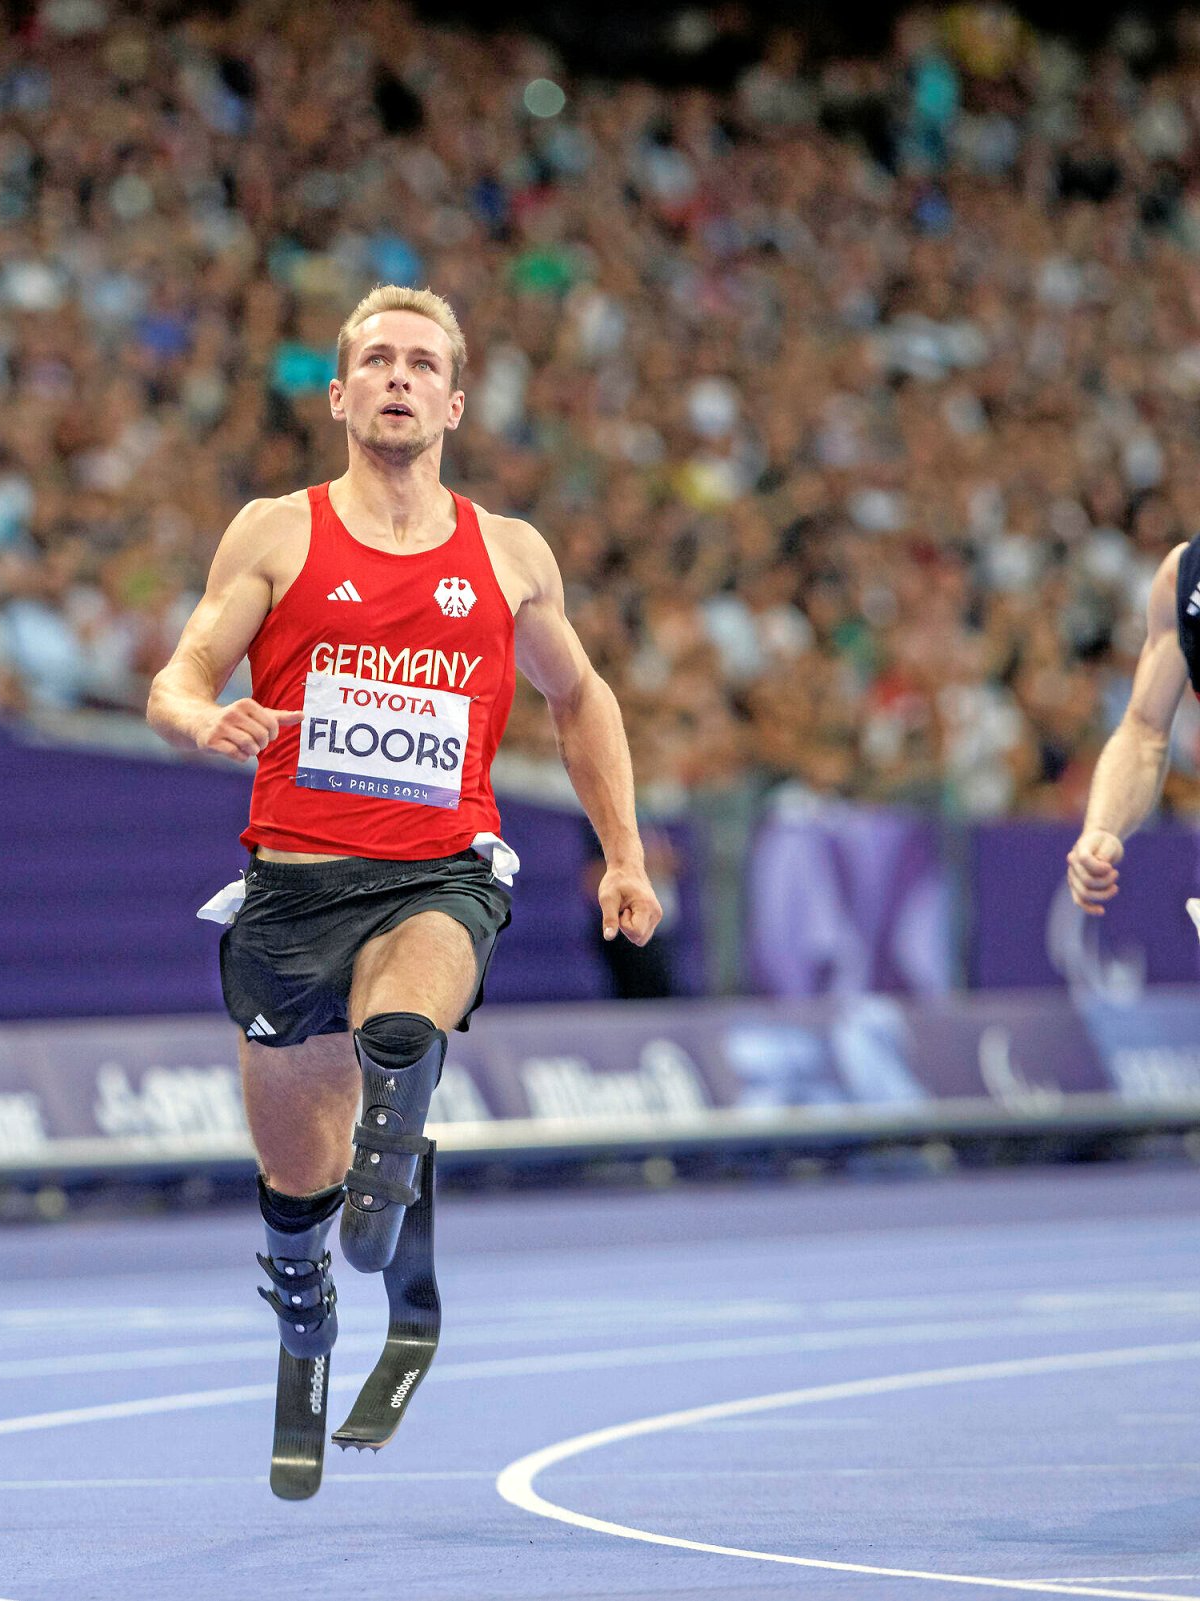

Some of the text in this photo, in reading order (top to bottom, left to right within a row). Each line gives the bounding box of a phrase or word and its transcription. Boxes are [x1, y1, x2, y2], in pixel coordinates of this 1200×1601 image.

[311, 642, 483, 688] GERMANY
[338, 687, 436, 717] TOYOTA
[308, 717, 461, 771] FLOORS
[350, 779, 429, 799] PARIS 2024
[310, 1355, 325, 1415] ottoboc
